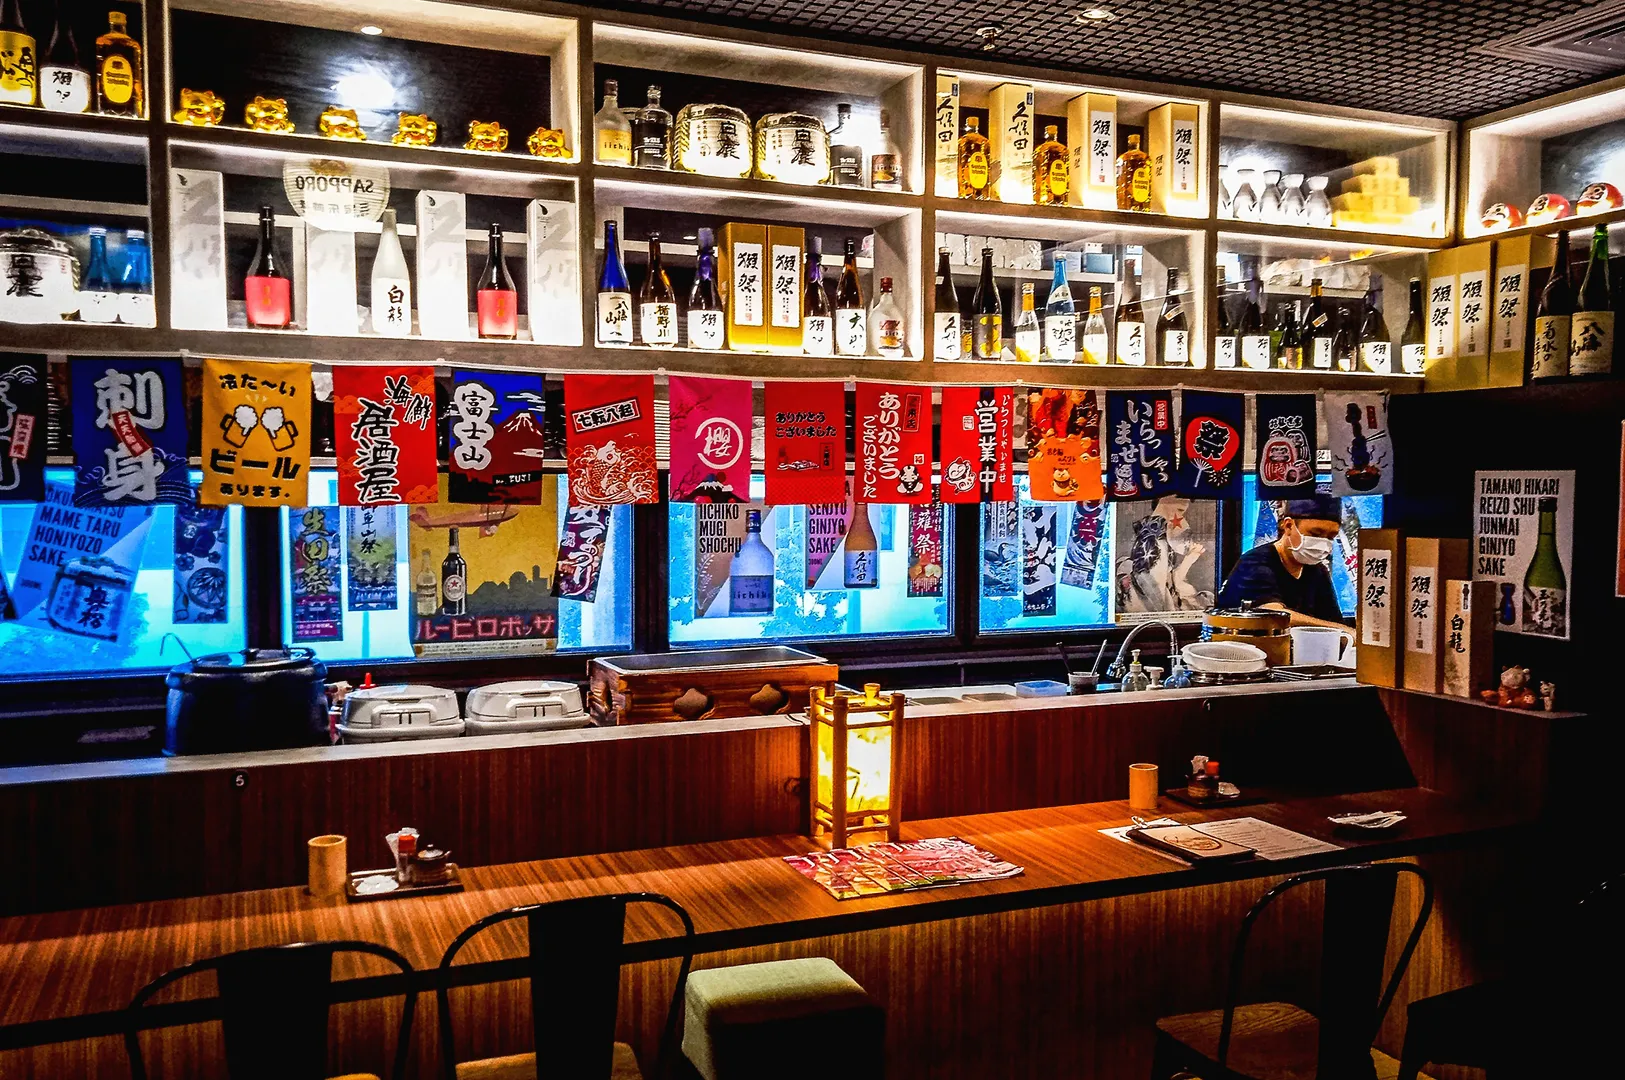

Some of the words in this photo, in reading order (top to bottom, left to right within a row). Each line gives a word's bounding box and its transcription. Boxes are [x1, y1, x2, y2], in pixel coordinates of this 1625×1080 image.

[1008, 101, 1029, 150] 久保田
[737, 252, 759, 294] 獺祭
[775, 254, 797, 295] 獺祭
[1431, 284, 1452, 327] 獺祭
[1462, 280, 1482, 324] 獺祭
[1498, 273, 1521, 318] 獺祭
[385, 376, 433, 430] 海鮮
[577, 403, 634, 428] 七転八起
[775, 411, 825, 424] ありがとう
[94, 369, 165, 501] 刺身
[462, 390, 487, 464] 富士山
[775, 425, 837, 438] ございました
[877, 391, 902, 480] ありがとう
[351, 397, 402, 503] 居酒屋
[862, 414, 878, 499] ございました
[974, 399, 999, 493] 営業中
[210, 448, 301, 479] ビール
[508, 474, 531, 485] FUJI
[1480, 478, 1521, 495] TAMANO
[1524, 478, 1560, 496] HIKARI
[40, 505, 84, 530] MAME
[86, 515, 122, 538] TARU
[700, 504, 739, 519] IICHIKO
[1480, 497, 1510, 515] REIZO
[1513, 497, 1535, 516] SHU
[34, 525, 103, 555] HONJYOZO
[700, 520, 727, 536] MUGI
[1478, 516, 1520, 536] JUNMAI
[28, 544, 66, 567] SAKE
[700, 537, 742, 553] SHOCHU
[809, 537, 836, 554] SAKE
[1479, 536, 1516, 556] GINJYO
[1478, 556, 1506, 576] SAKE
[1365, 557, 1388, 608] 獺祭
[1411, 575, 1431, 619] 獺祭
[1449, 614, 1465, 653] 白龍
[234, 774, 245, 787] 5
